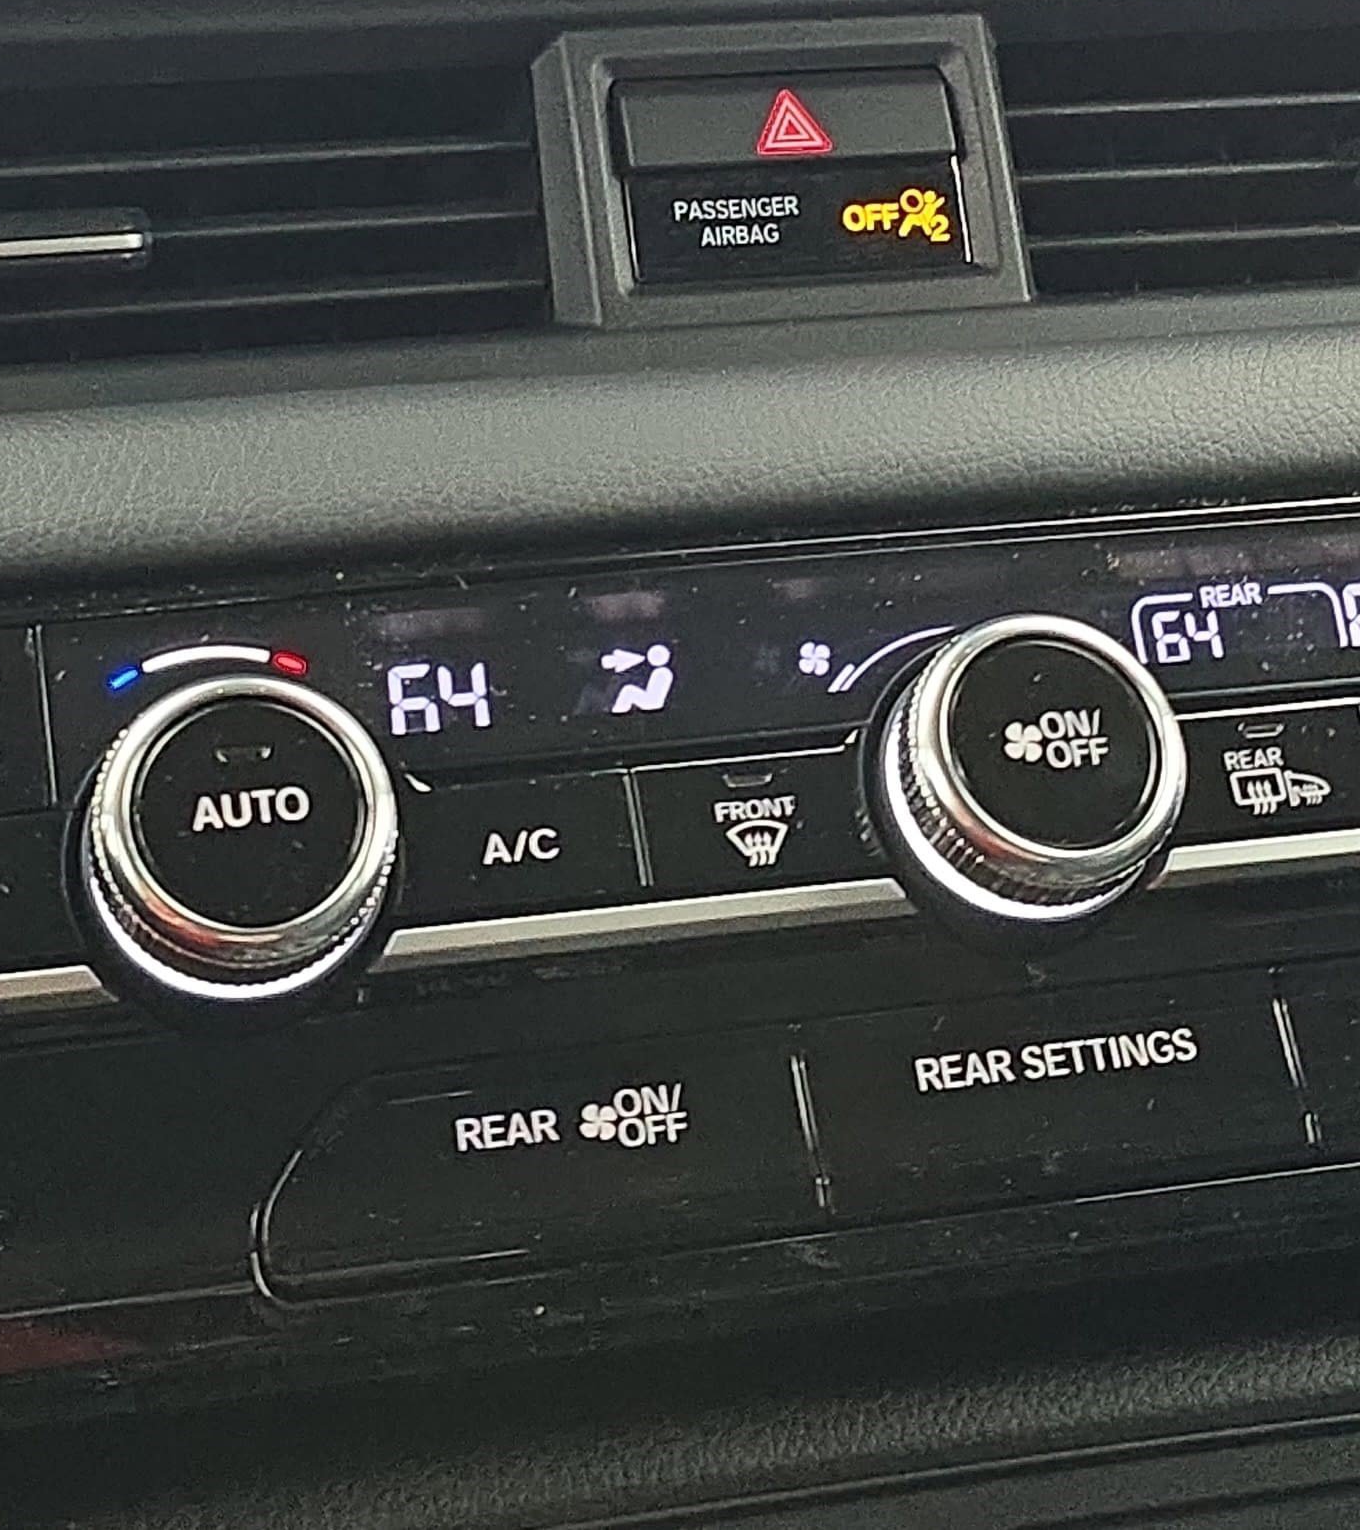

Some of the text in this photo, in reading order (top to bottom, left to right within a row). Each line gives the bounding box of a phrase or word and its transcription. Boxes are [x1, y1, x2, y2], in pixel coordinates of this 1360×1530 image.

[674, 195, 800, 223] PASSENGER
[842, 202, 900, 234] OFF
[700, 222, 780, 248] AIRBAG
[1200, 582, 1262, 609] REAR
[1151, 610, 1225, 664] 64
[387, 661, 491, 736] 64
[1040, 707, 1103, 739] ON/
[1045, 733, 1110, 769] OFF
[1224, 746, 1285, 772] REAR
[191, 786, 311, 833] AUTO
[713, 795, 795, 822] FRONT
[481, 827, 561, 866] A/C
[915, 1027, 1198, 1092] REAR SETTINGS
[614, 1082, 685, 1120] ON/
[455, 1110, 560, 1152] REAR
[618, 1110, 690, 1149] OFF
